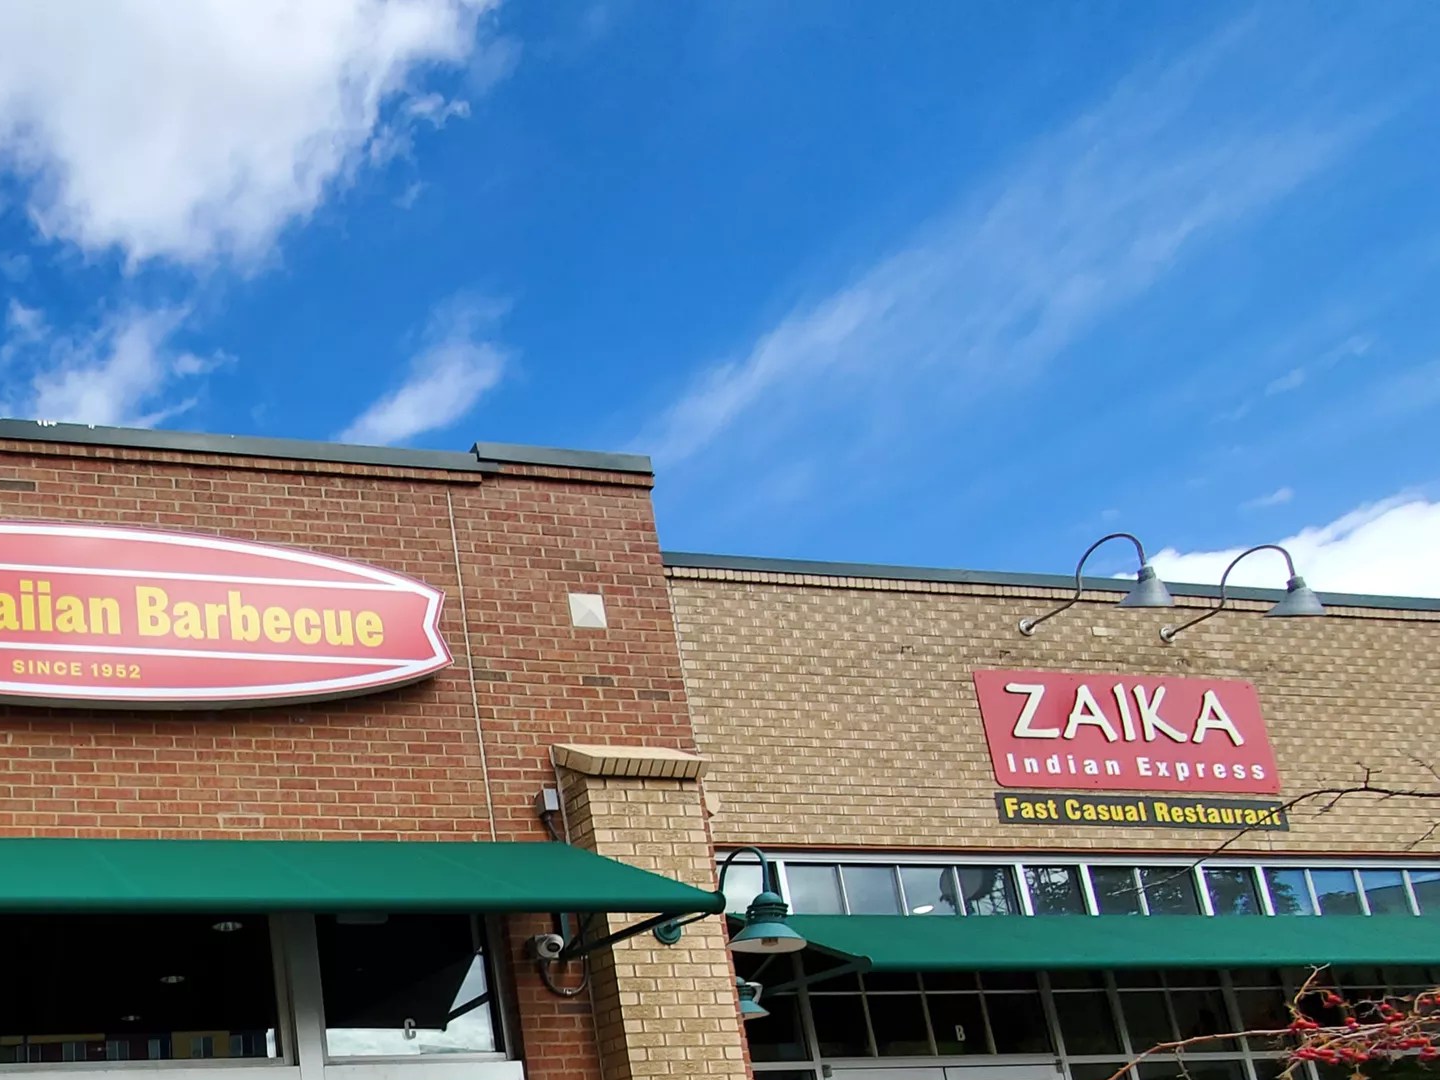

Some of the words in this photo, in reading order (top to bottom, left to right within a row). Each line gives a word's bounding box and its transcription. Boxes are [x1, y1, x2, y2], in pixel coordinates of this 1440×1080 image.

[135, 585, 384, 647] Barbecue
[12, 659, 82, 676] SINCE
[90, 662, 141, 679] 1952
[1004, 682, 1245, 747] ZAIKA
[1006, 753, 1121, 775] Indian
[1136, 755, 1265, 781] Express
[1004, 797, 1058, 820] Fast
[1065, 798, 1146, 822] Casual
[1155, 801, 1281, 826] Restaurant
[404, 1018, 416, 1040] C
[955, 1024, 965, 1041] B
